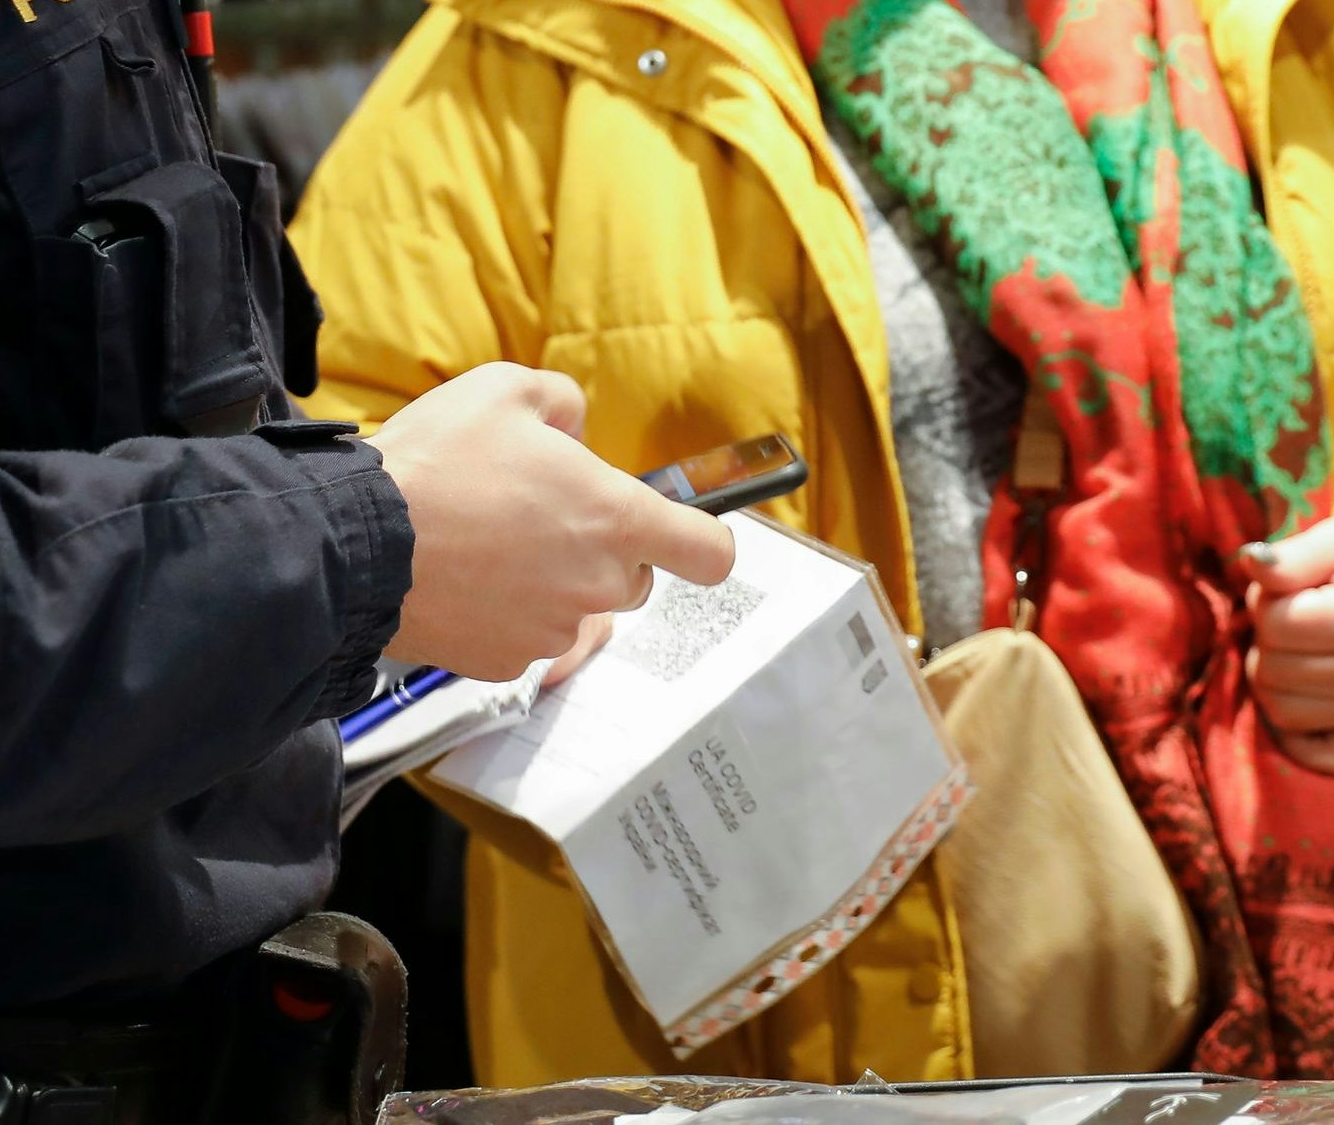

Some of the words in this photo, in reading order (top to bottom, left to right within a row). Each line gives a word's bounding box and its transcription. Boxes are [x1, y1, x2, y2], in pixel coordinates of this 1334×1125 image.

[688, 749, 740, 833] Certificate
[706, 736, 727, 764] UA
[720, 763, 758, 815] COVID
